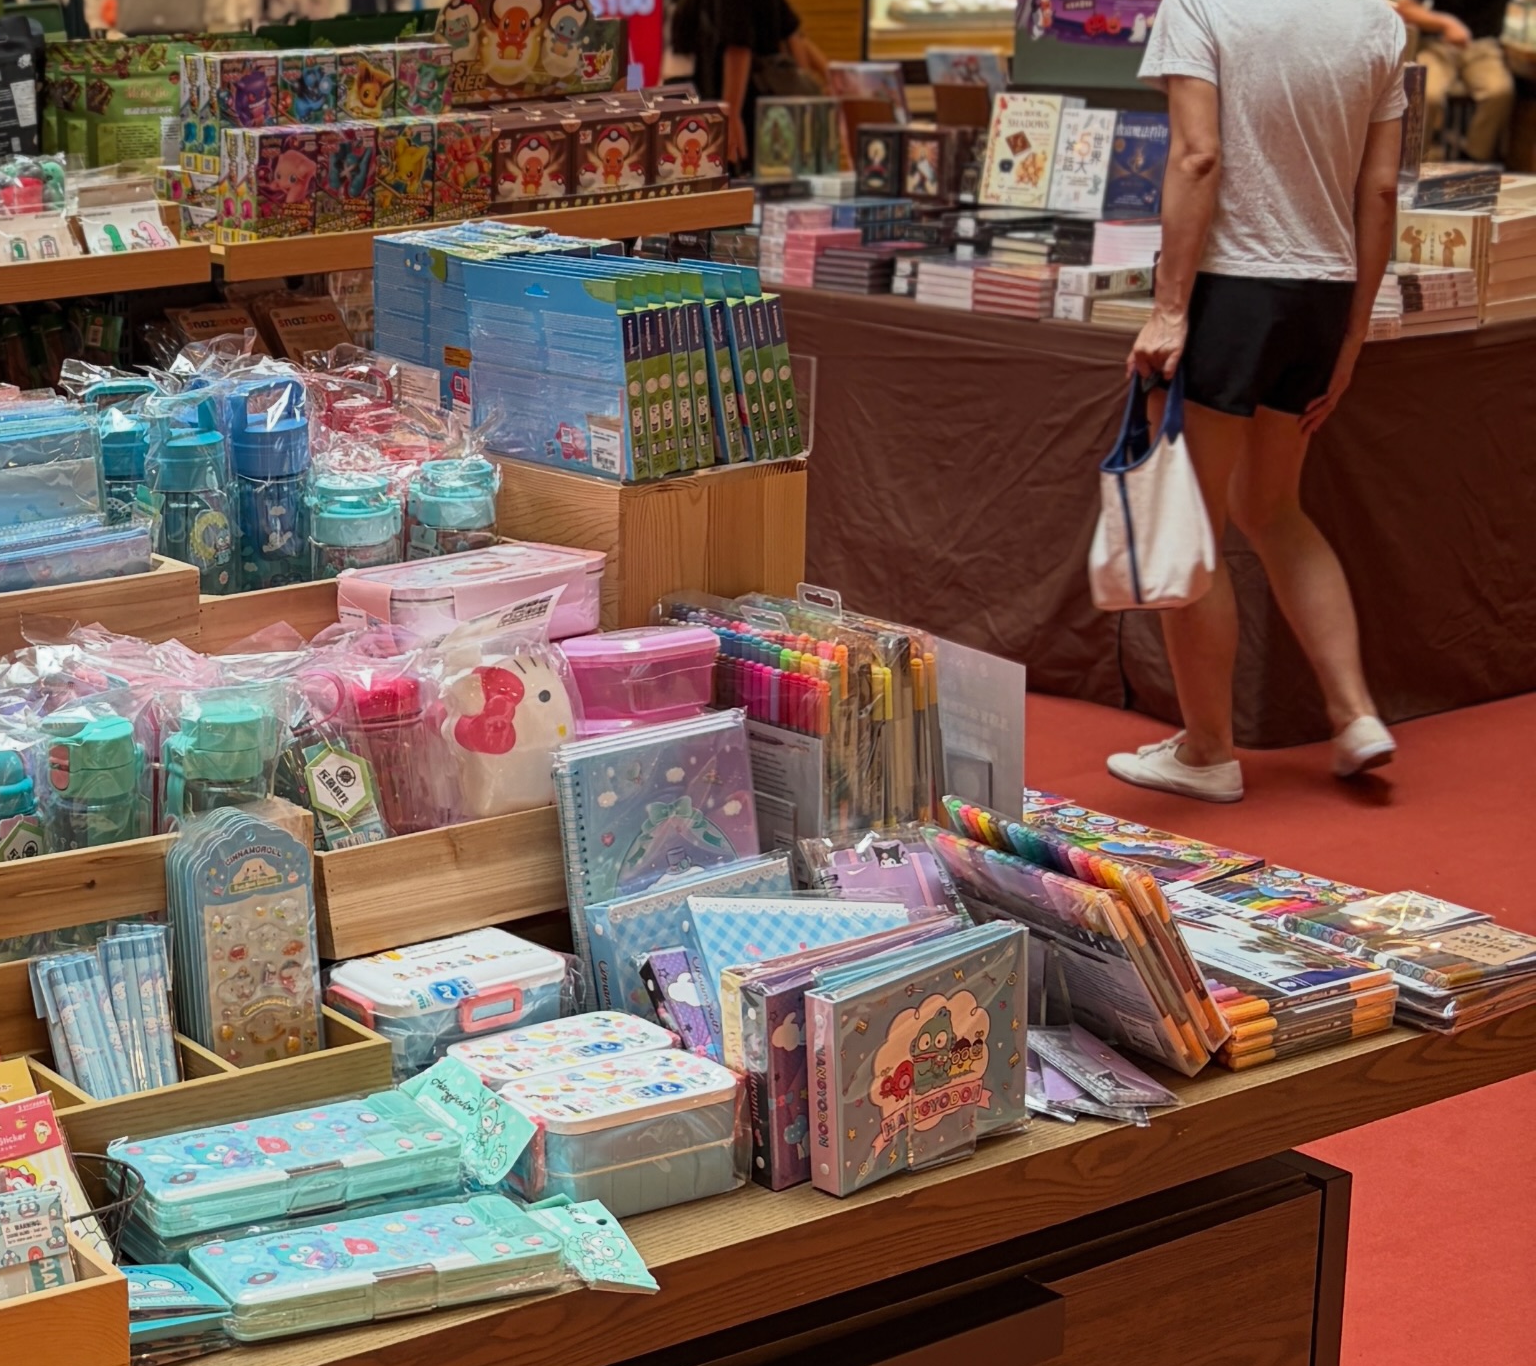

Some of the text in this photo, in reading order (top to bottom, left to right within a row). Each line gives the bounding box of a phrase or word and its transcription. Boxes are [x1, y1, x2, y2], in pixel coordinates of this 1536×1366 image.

[185, 315, 248, 332] snazaroo
[277, 312, 336, 329] snazaroo
[224, 845, 283, 867] CINNAMOROLL
